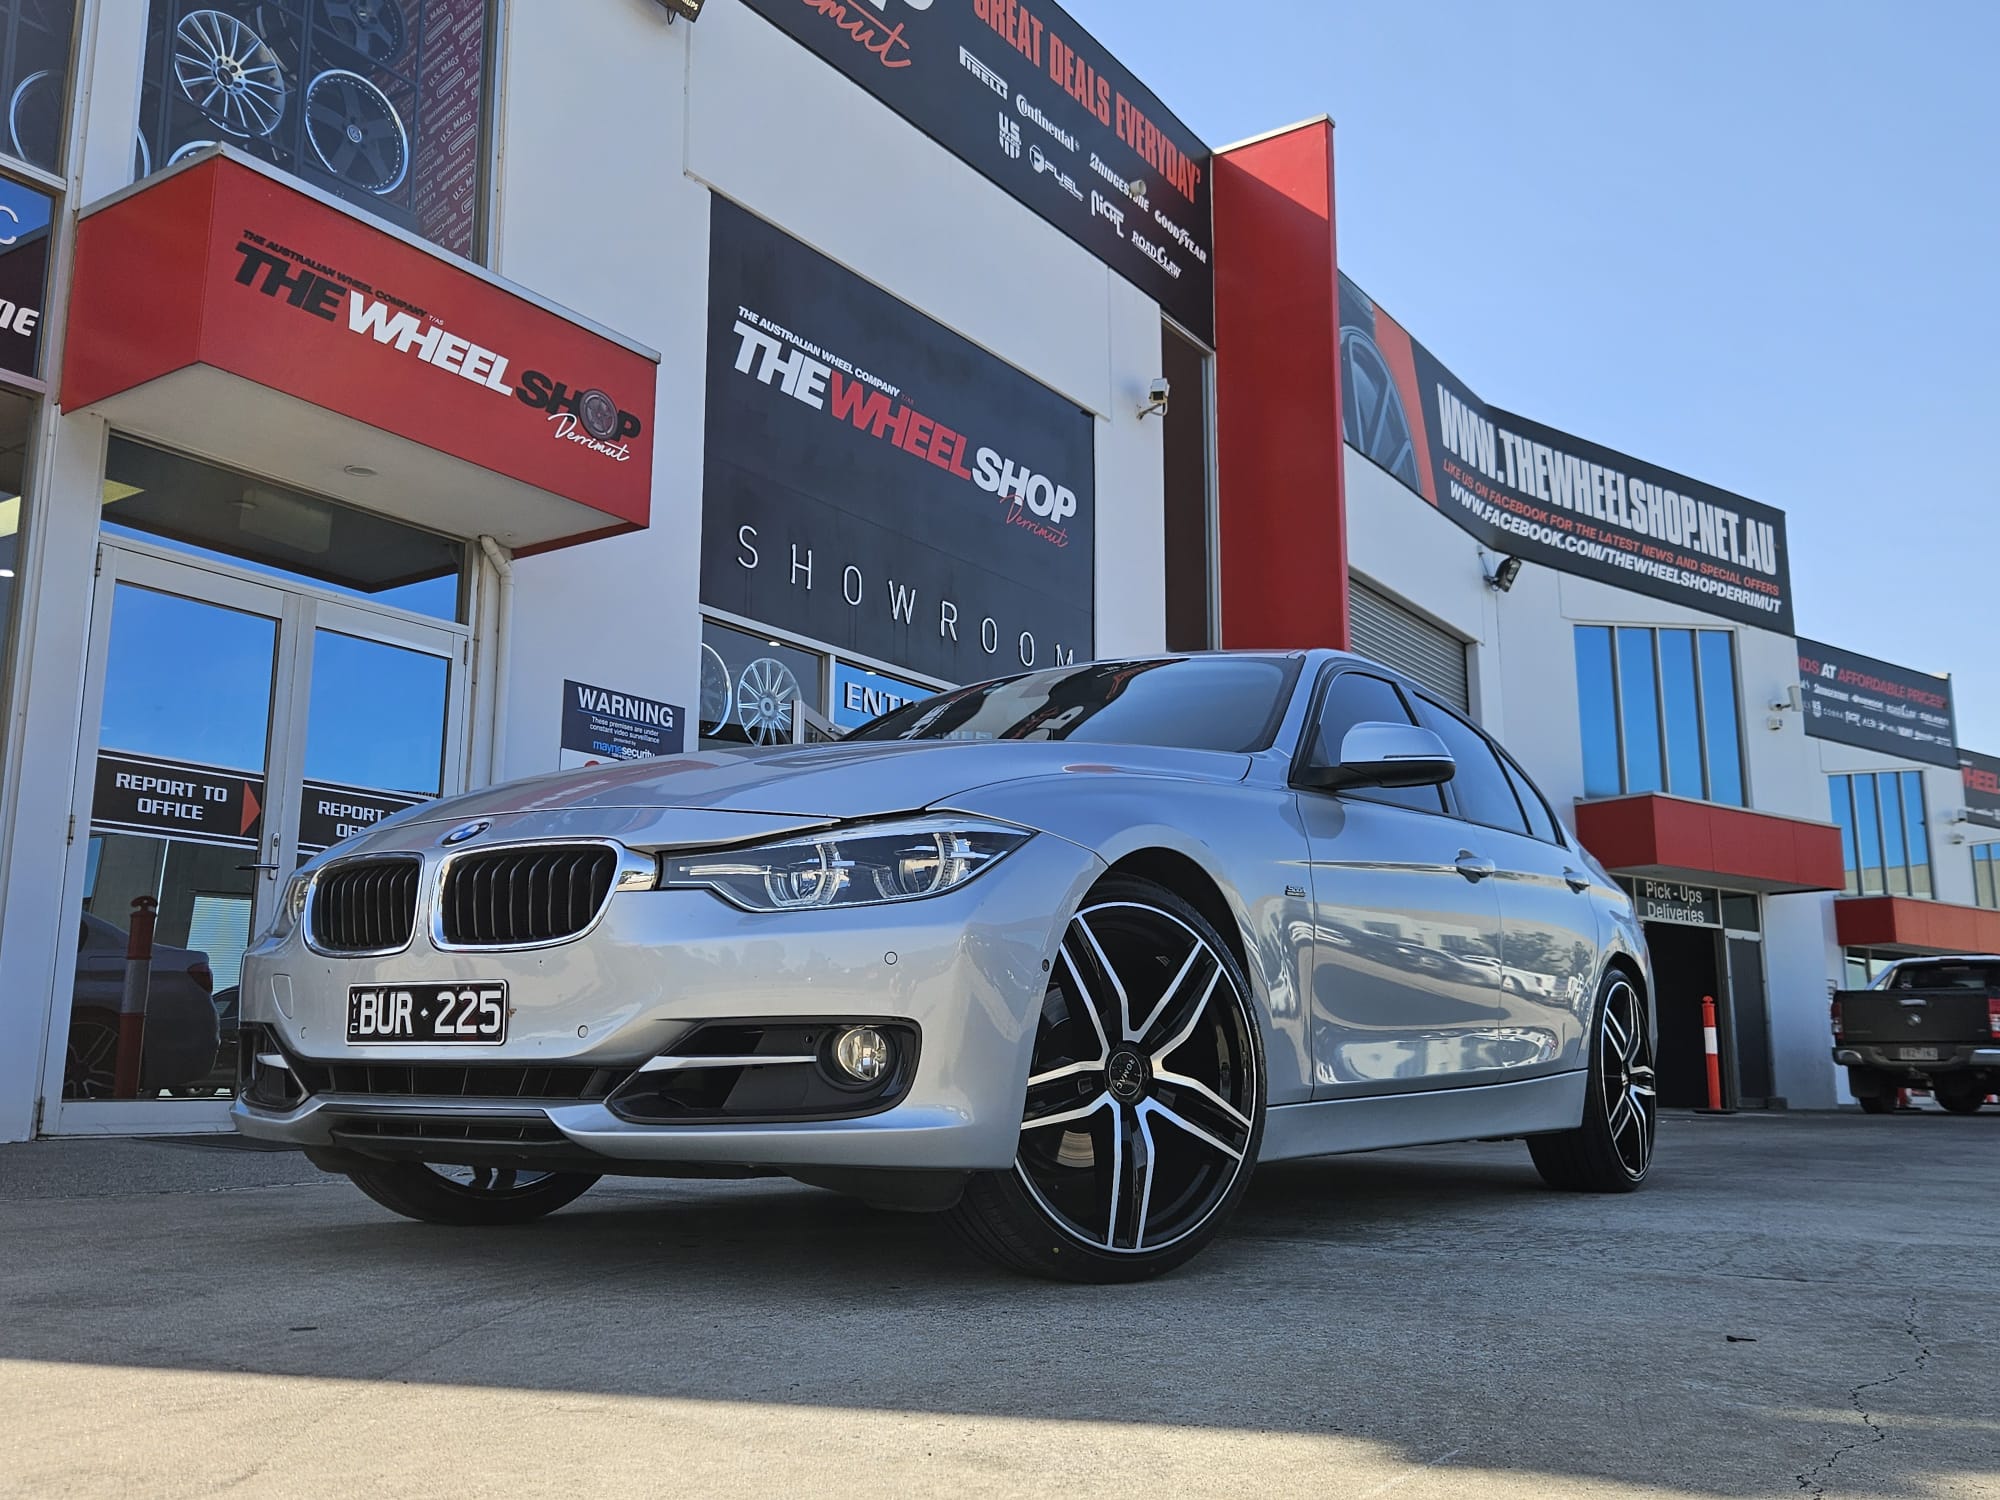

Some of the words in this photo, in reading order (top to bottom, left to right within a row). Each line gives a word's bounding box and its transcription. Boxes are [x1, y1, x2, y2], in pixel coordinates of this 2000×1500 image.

[959, 46, 1008, 100] PIRELLI
[1049, 32, 1110, 127] DEALS
[1016, 94, 1075, 152] Continental
[1045, 160, 1083, 199] FUEL
[1089, 152, 1150, 212] BRIDGESNE
[1155, 209, 1207, 264] GOODYEAR
[244, 229, 267, 246] THE
[266, 239, 336, 277] AUSTRALIAN
[337, 271, 373, 295] WHEEL
[375, 289, 427, 317] COMPANY
[235, 241, 347, 322] THE
[349, 289, 513, 397] WHEEL
[738, 305, 759, 324] THE
[759, 317, 820, 357] AUSTRALIAN
[822, 349, 853, 374] WHEEL
[854, 367, 900, 398] COMPANY
[548, 412, 630, 462] Derrimut
[733, 319, 832, 411] THE
[831, 370, 971, 481] WHEEL
[972, 447, 1077, 524] SHOP
[1437, 383, 1777, 575] WWW.THEWHEELSHOP.NET.AU
[999, 494, 1068, 548] Derrimut
[1443, 458, 1461, 481] LIKE
[1462, 472, 1474, 490] US
[1475, 482, 1488, 499] ON
[1489, 490, 1549, 523] FACEBOOK
[1550, 514, 1573, 532] FOR
[1575, 522, 1597, 539] THE
[1598, 528, 1640, 553] LATEST
[1641, 543, 1674, 564] NEWS
[1675, 555, 1698, 571] AND
[1700, 562, 1741, 585] SPECIAL
[1743, 577, 1780, 596] OFFERS
[1450, 480, 1782, 614] WWW.FACEBOOK.COM/THEWHEELSHOPDERRIMUT
[737, 525, 1074, 667] SHOWROOM
[577, 686, 674, 728] WARNING
[844, 682, 914, 717] ENT
[1820, 663, 1837, 680] AT
[1837, 668, 1905, 699] AFFORDABLE
[589, 724, 613, 734] constant
[613, 728, 629, 737] video
[629, 732, 660, 744] surveillance
[591, 715, 609, 726] These
[609, 721, 634, 731] premises
[643, 728, 659, 737] under
[115, 772, 197, 798] REPORT
[203, 785, 228, 803] TO
[137, 797, 204, 821] OFFICE
[318, 800, 385, 823] REPORT
[1646, 881, 1671, 900] Pick
[1680, 885, 1702, 906] Ups
[1647, 901, 1704, 923] Deliveries
[359, 991, 413, 1035] BUR
[434, 990, 502, 1034] 225
